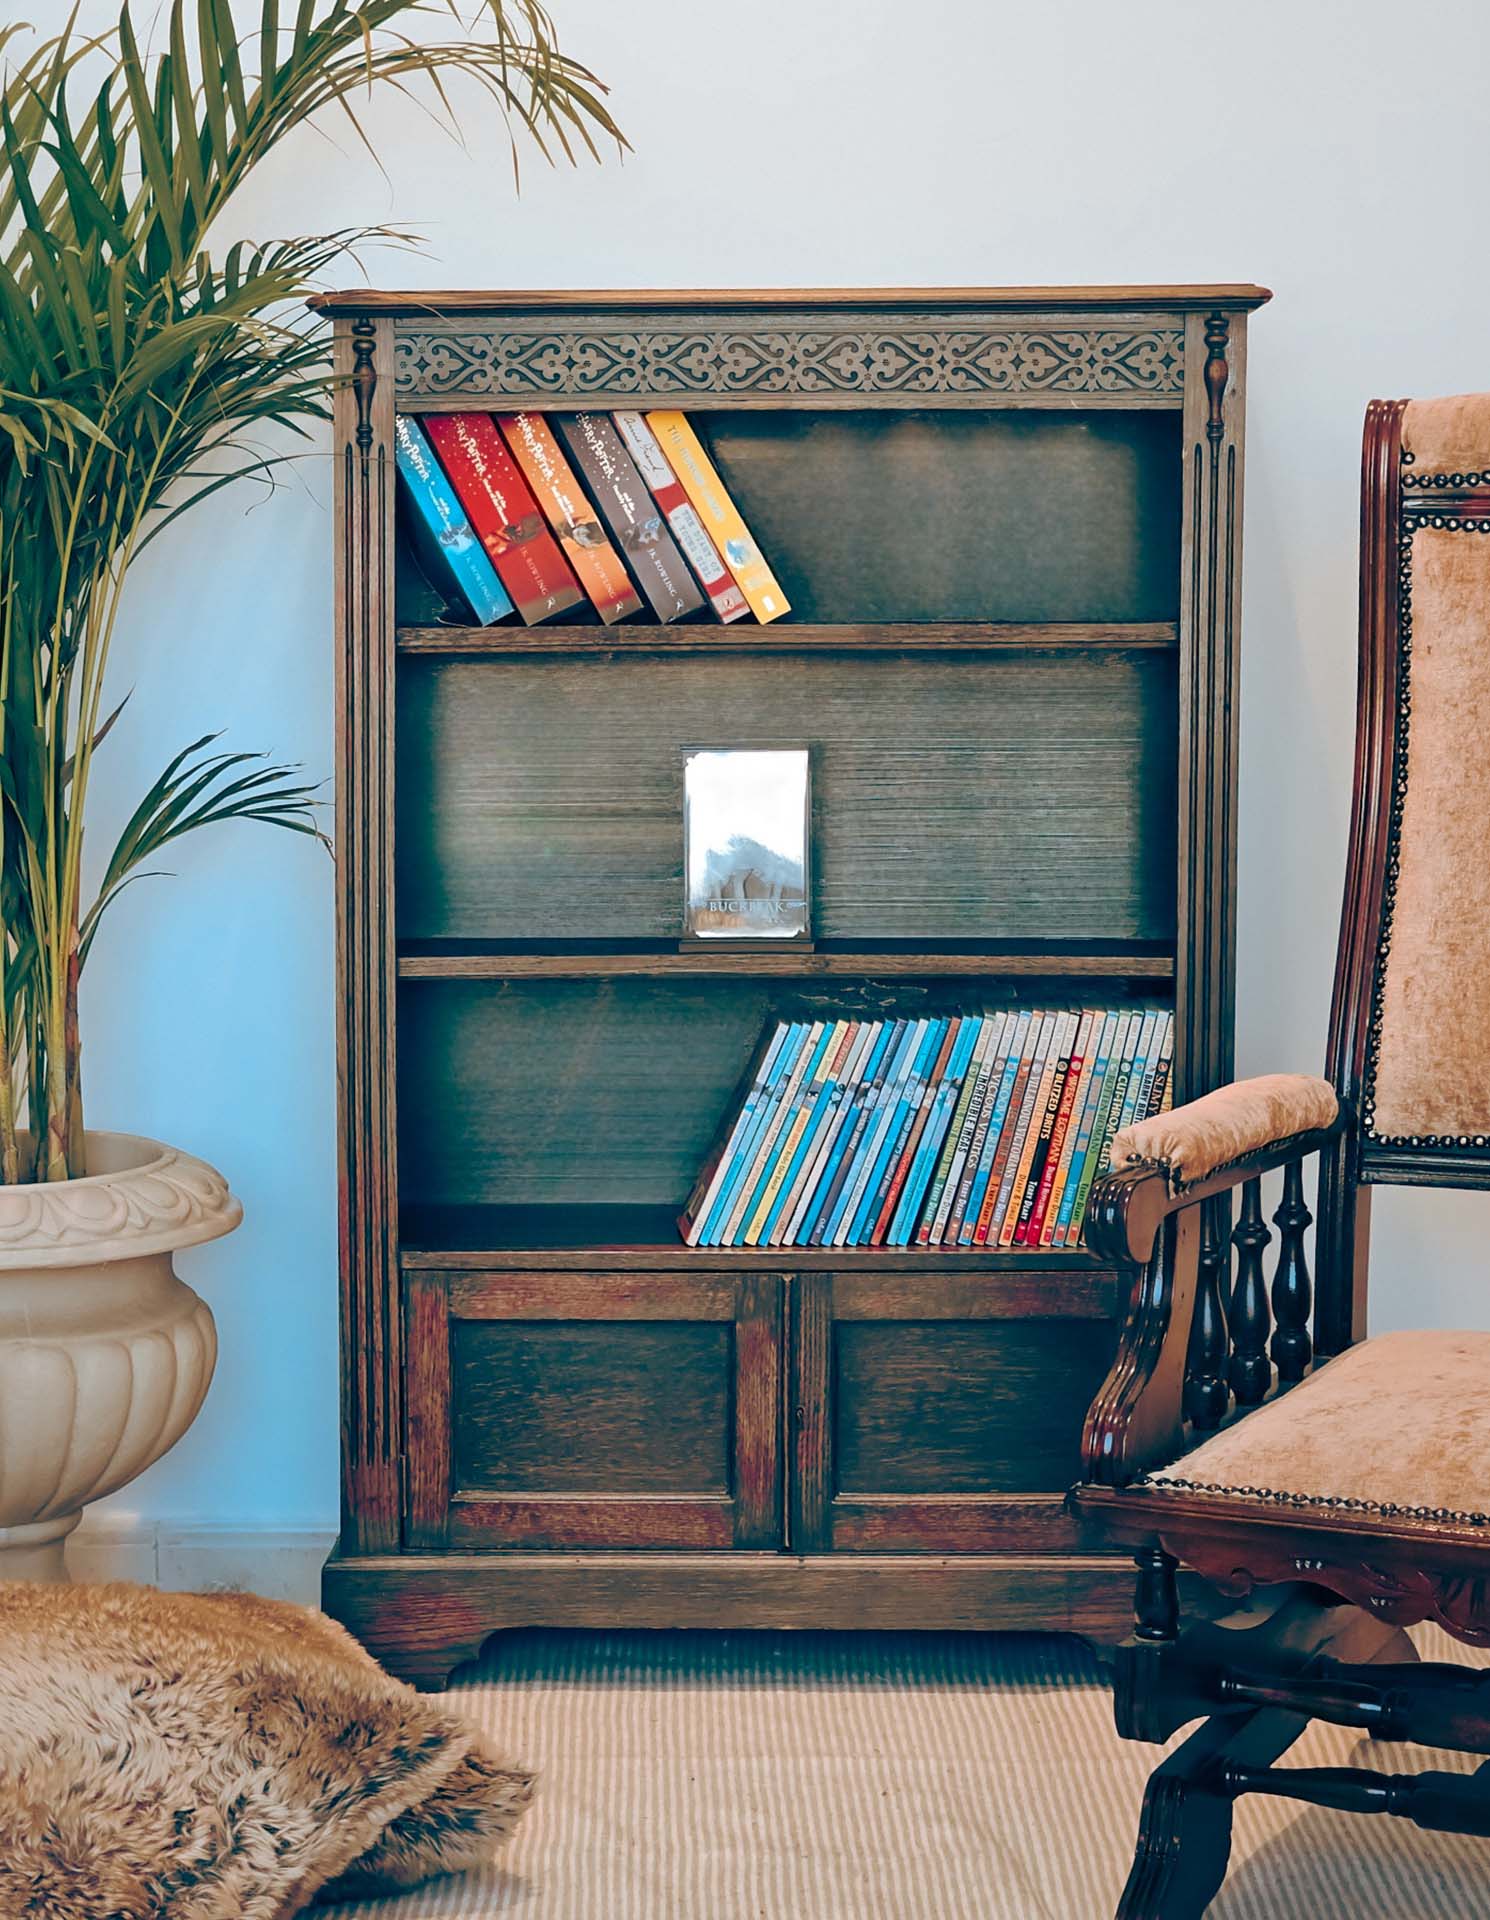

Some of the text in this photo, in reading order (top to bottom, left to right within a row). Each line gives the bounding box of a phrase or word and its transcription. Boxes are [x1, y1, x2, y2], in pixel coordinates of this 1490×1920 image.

[389, 413, 433, 484] HARRY POTTER
[449, 413, 490, 477] HARRY POTTER
[511, 412, 557, 481] HARRY POTTER
[573, 410, 619, 480] HARRY POTTER
[622, 491, 636, 511] and the
[678, 525, 697, 553] YOUNG
[695, 556, 711, 578] GIRL
[681, 508, 720, 574] THE DIARY OF
[469, 563, 491, 603] ROWLING
[524, 556, 549, 596] ROWLING
[592, 560, 617, 599] ROWLING
[652, 558, 677, 597] ROWLING
[964, 1073, 988, 1127] INCREDIBLE
[980, 1072, 1001, 1119] VICIOUS
[992, 1074, 1013, 1124] GROOVY
[1017, 1075, 1039, 1128] VILLAINOUS
[1032, 1072, 1052, 1122] TERRIBLE
[1046, 1072, 1064, 1112] BLITZED
[1059, 1071, 1078, 1115] AWESOME
[1098, 1073, 1115, 1112] ROTTEN
[1105, 1074, 1128, 1138] CUT-THROAT
[1134, 1073, 1152, 1123] BARMY BRIT
[1148, 1074, 1165, 1114] SLIMY
[847, 1108, 870, 1150] HORRID HENRY
[902, 1108, 916, 1132] HORRID
[949, 1114, 964, 1136] FIRST
[1040, 1112, 1055, 1140] BRITS
[1089, 1113, 1106, 1154] ROMANS
[1120, 1109, 1132, 1129] AZTE
[941, 1135, 958, 1163] WORLD
[957, 1126, 973, 1154] INCAS
[966, 1119, 988, 1170] VIKINGS
[979, 1126, 1000, 1171] GREEKS
[1004, 1127, 1026, 1179] VICTORIANS
[1020, 1124, 1040, 1167] TUDORS
[1047, 1116, 1068, 1164] EGYPTIANS
[1059, 1121, 1079, 1170] NORMANS
[1097, 1140, 1112, 1169] CELTS
[776, 1164, 785, 1176] the
[1014, 1173, 1026, 1194] DEARY
[1044, 1165, 1055, 1182] DEARY
[924, 1182, 943, 1221] TERRY DEARY
[938, 1182, 956, 1219] TERRY DEARY
[953, 1178, 972, 1218] TERRY DEARY
[981, 1182, 998, 1221] TERRY DEARY
[994, 1184, 1011, 1222] TERRY DEARY
[1020, 1179, 1038, 1220] TERRY DEARY
[1047, 1184, 1063, 1223] TERRY DEARY
[1059, 1182, 1076, 1221] TERRY DEARY
[1072, 1181, 1089, 1221] TERRY DEARY
